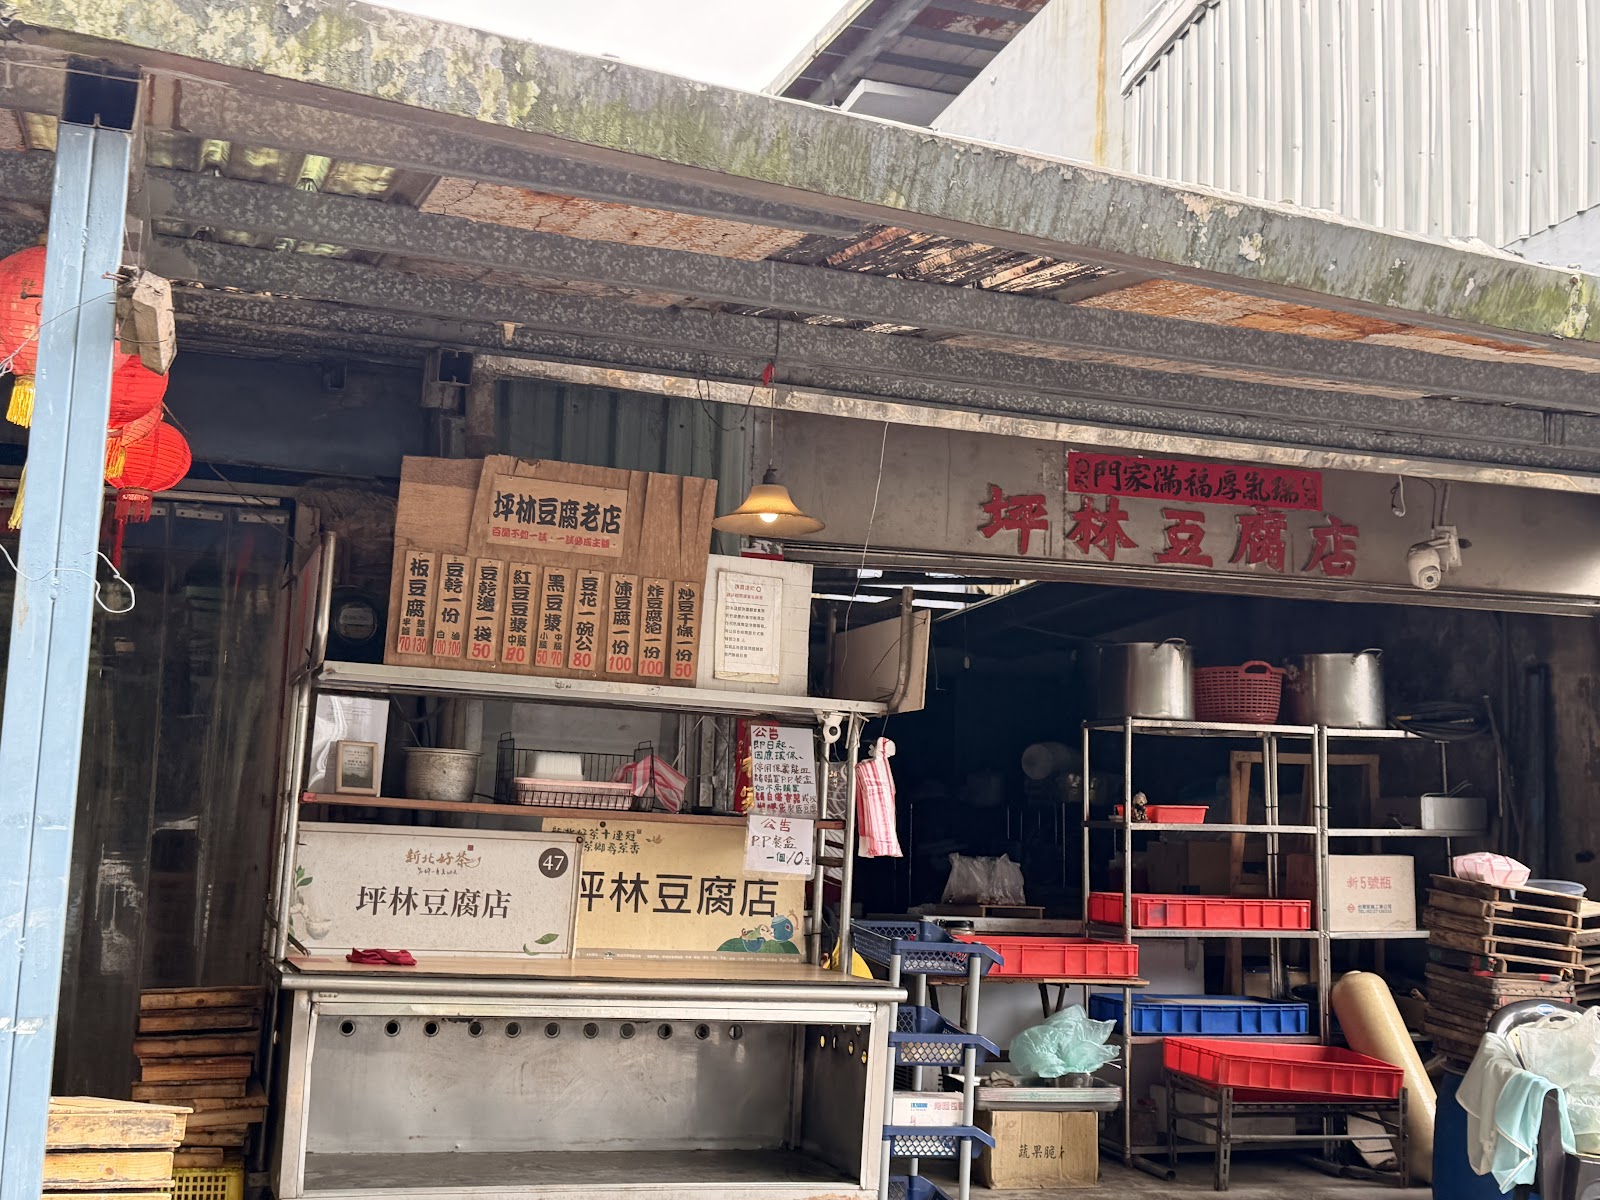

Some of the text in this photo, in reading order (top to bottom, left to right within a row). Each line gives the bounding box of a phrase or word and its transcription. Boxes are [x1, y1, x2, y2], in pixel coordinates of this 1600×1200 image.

[493, 491, 622, 534] 坪林豆腐老店
[977, 482, 1360, 578] 坪林豆腐店
[406, 558, 430, 617] 板豆腐
[441, 563, 464, 624] 豆乾一份
[509, 569, 532, 634] 紅豆豆漿
[544, 574, 565, 632] 黑豆漿
[575, 576, 599, 652] 豆花一碗公
[611, 580, 633, 656] 凍豆腐一份
[643, 584, 665, 660] 炸豆腐泡一份
[675, 588, 696, 662] 炒豆干條一份
[399, 637, 427, 653] 70 130
[434, 640, 460, 656] 100 100
[472, 643, 491, 659] 50
[536, 650, 562, 666] 50 70
[573, 652, 592, 668] 80
[609, 656, 632, 672] 100
[640, 660, 664, 676] 100
[674, 663, 692, 678] 50
[753, 727, 778, 740] 公告
[761, 818, 791, 832] 公告
[405, 848, 471, 868] 新北好茶
[543, 855, 565, 871] 47
[1347, 876, 1392, 890] 新5號瓶
[356, 886, 512, 919] 坪林豆腐店
